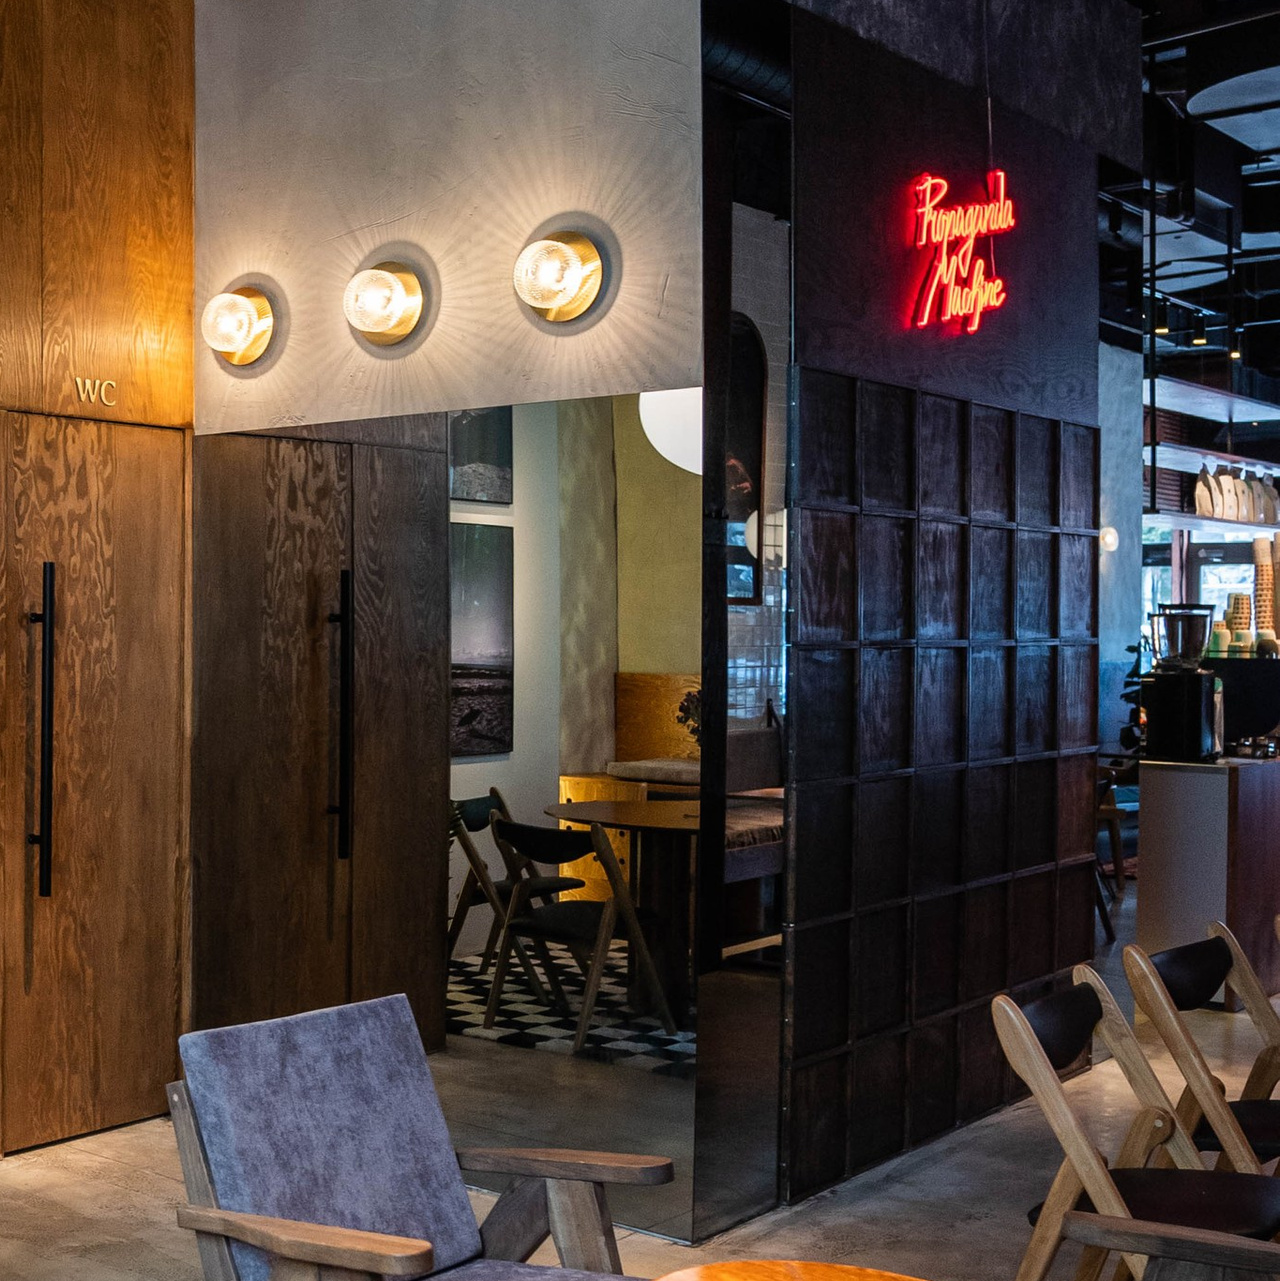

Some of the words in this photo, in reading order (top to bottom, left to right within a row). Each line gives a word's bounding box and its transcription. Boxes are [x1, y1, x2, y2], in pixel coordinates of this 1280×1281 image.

[916, 170, 1015, 278] Propaganda
[917, 254, 1007, 332] Machine
[75, 376, 116, 407] WC
